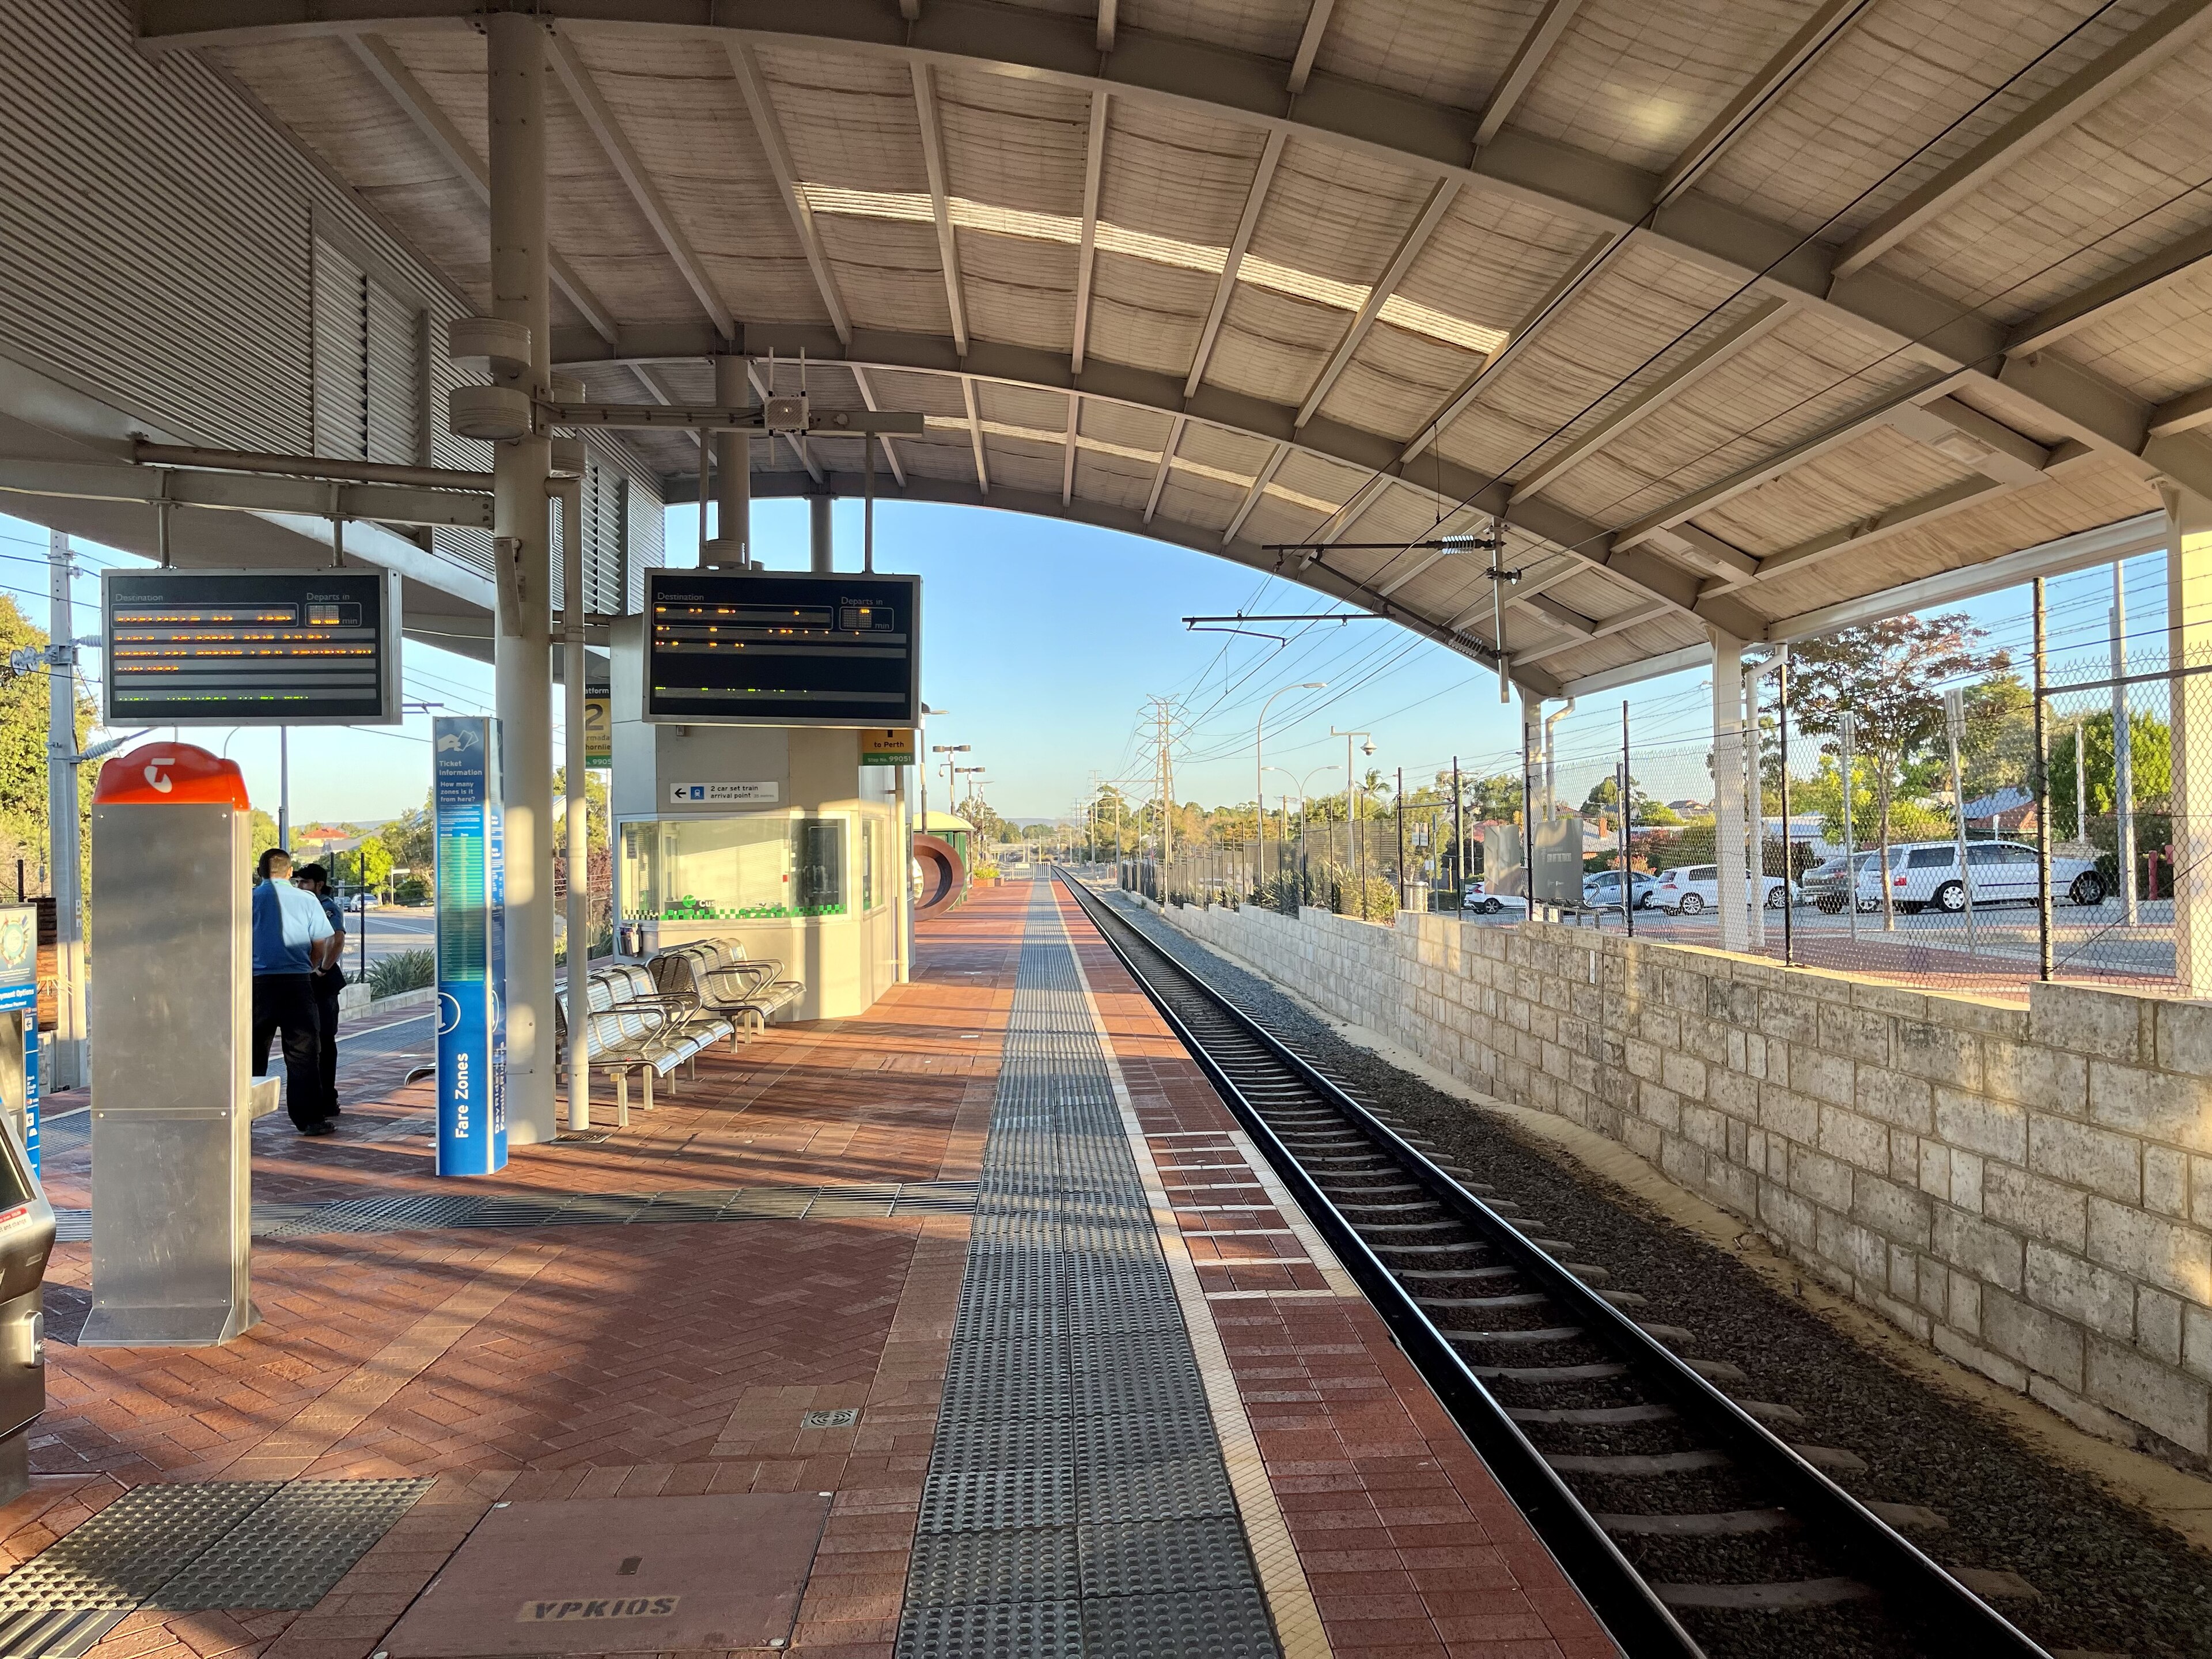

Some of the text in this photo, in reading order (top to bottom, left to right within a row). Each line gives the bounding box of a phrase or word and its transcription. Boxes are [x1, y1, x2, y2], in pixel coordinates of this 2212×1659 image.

[115, 593, 164, 602] Destination
[306, 592, 340, 602] Departs
[657, 592, 704, 601] Destination
[841, 597, 873, 607] Departs
[585, 703, 604, 730] 2
[0, 988, 35, 1001] yment Options
[454, 1052, 469, 1138] Fare Zones
